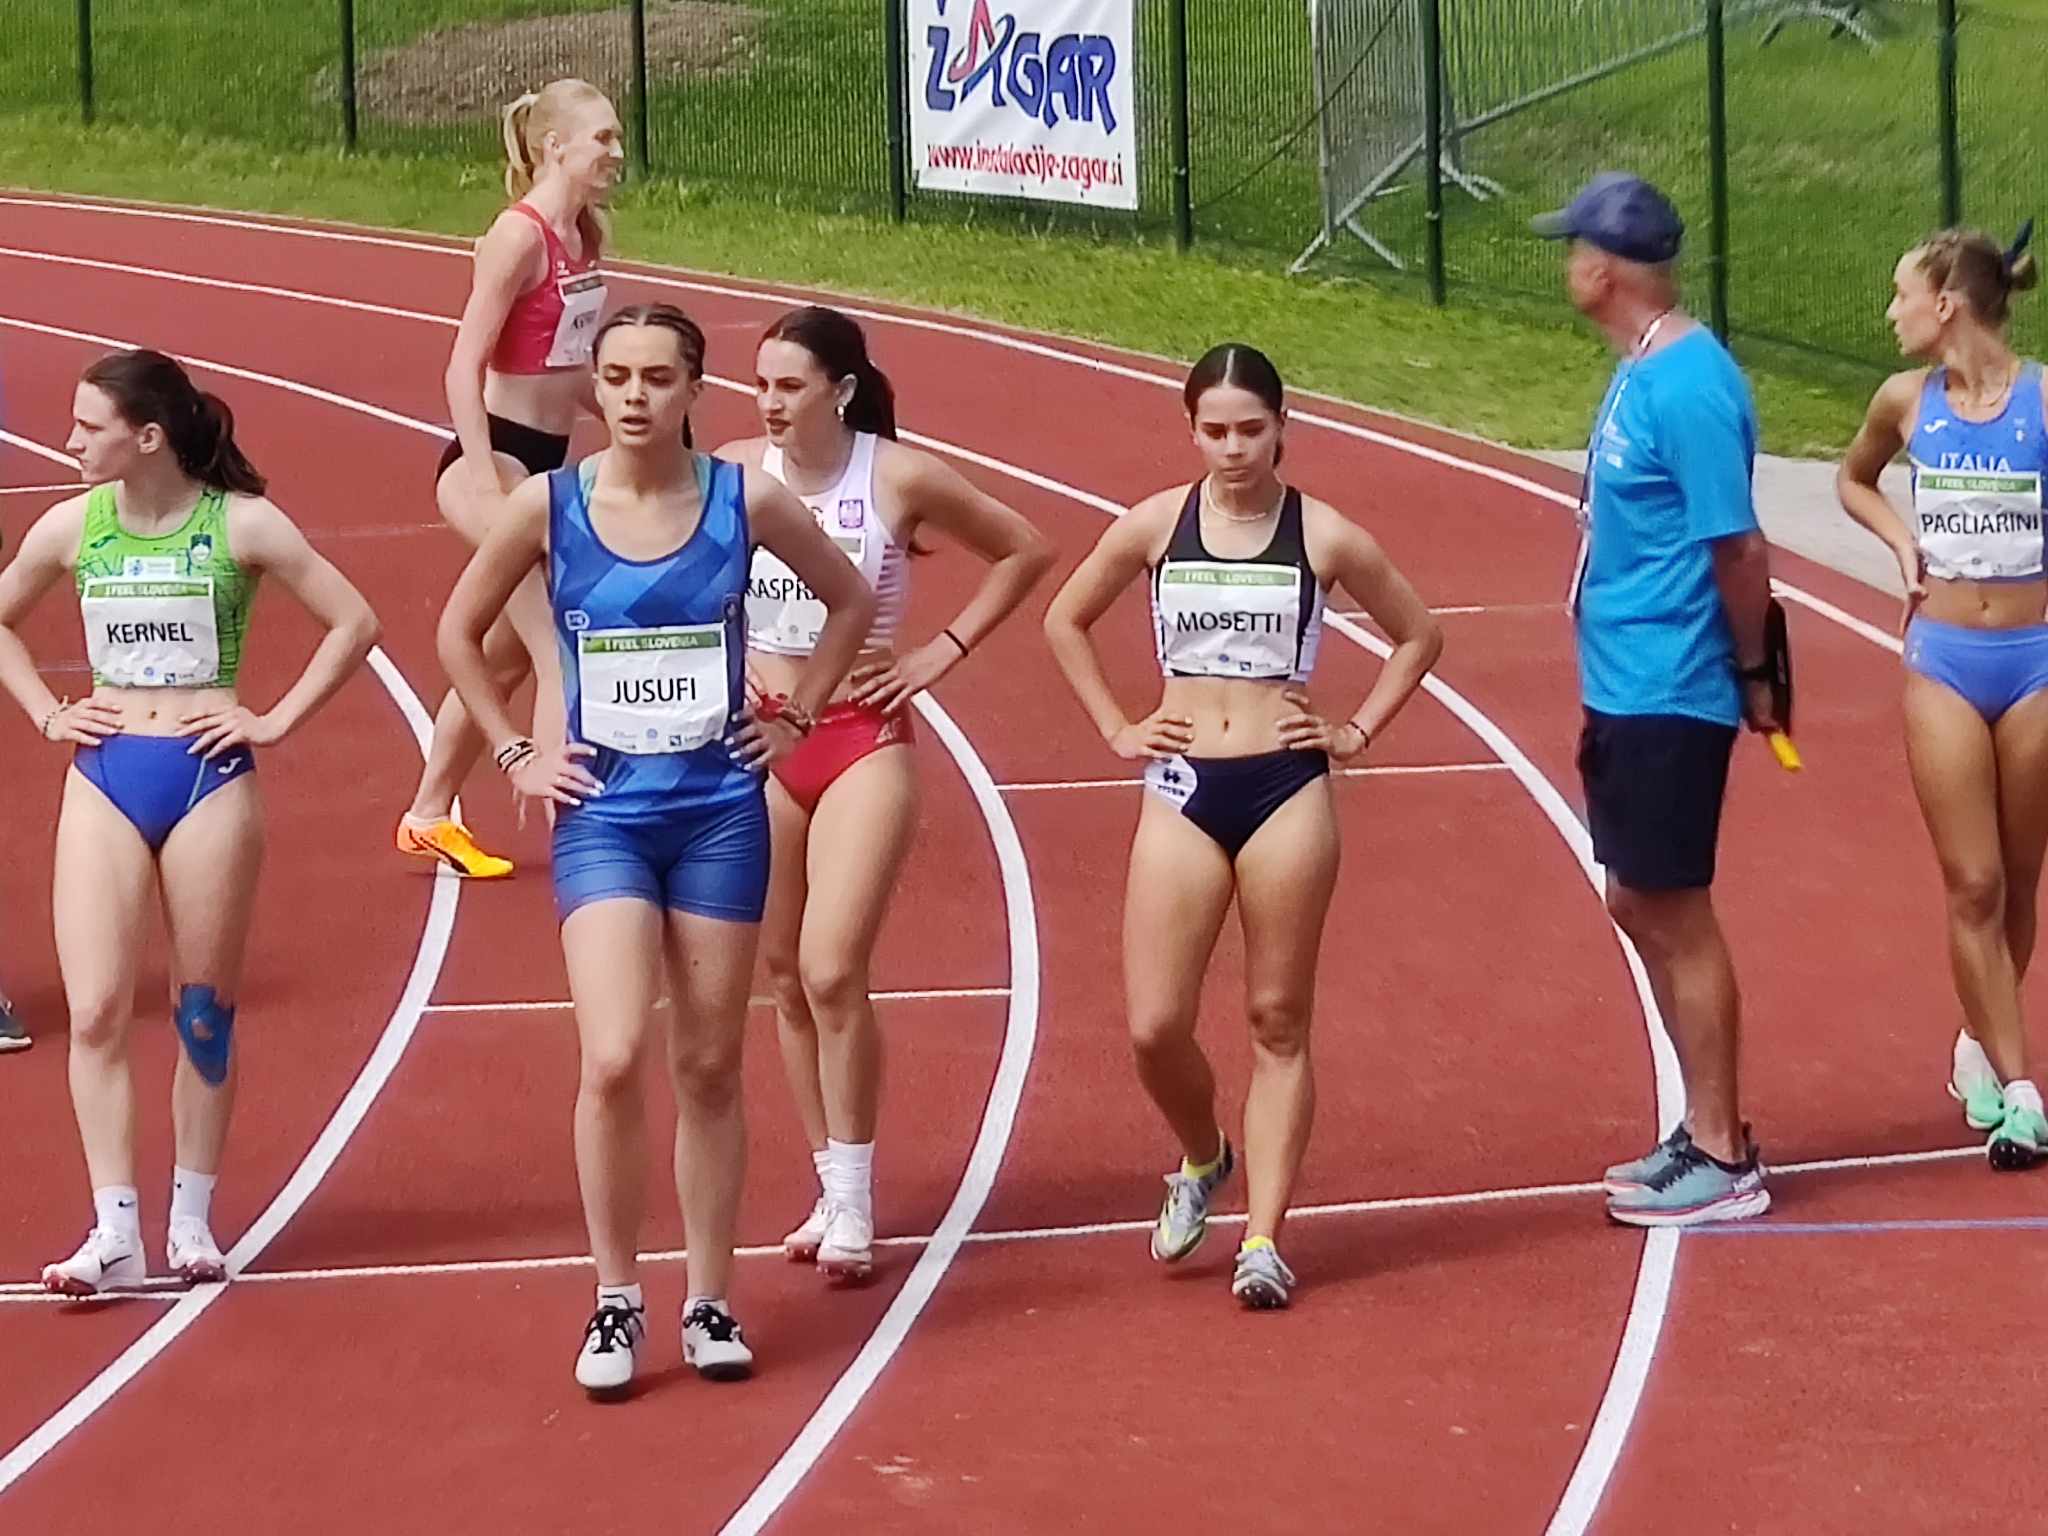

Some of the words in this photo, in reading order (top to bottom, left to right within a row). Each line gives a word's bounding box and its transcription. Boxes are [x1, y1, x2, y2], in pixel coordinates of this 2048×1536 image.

[1939, 452, 2012, 473] ITALIA
[1921, 513, 2038, 534] PAGLIARINI
[107, 622, 194, 643] KERNEL
[1177, 612, 1281, 633] MOSETTI
[611, 677, 696, 704] JUSUFI
